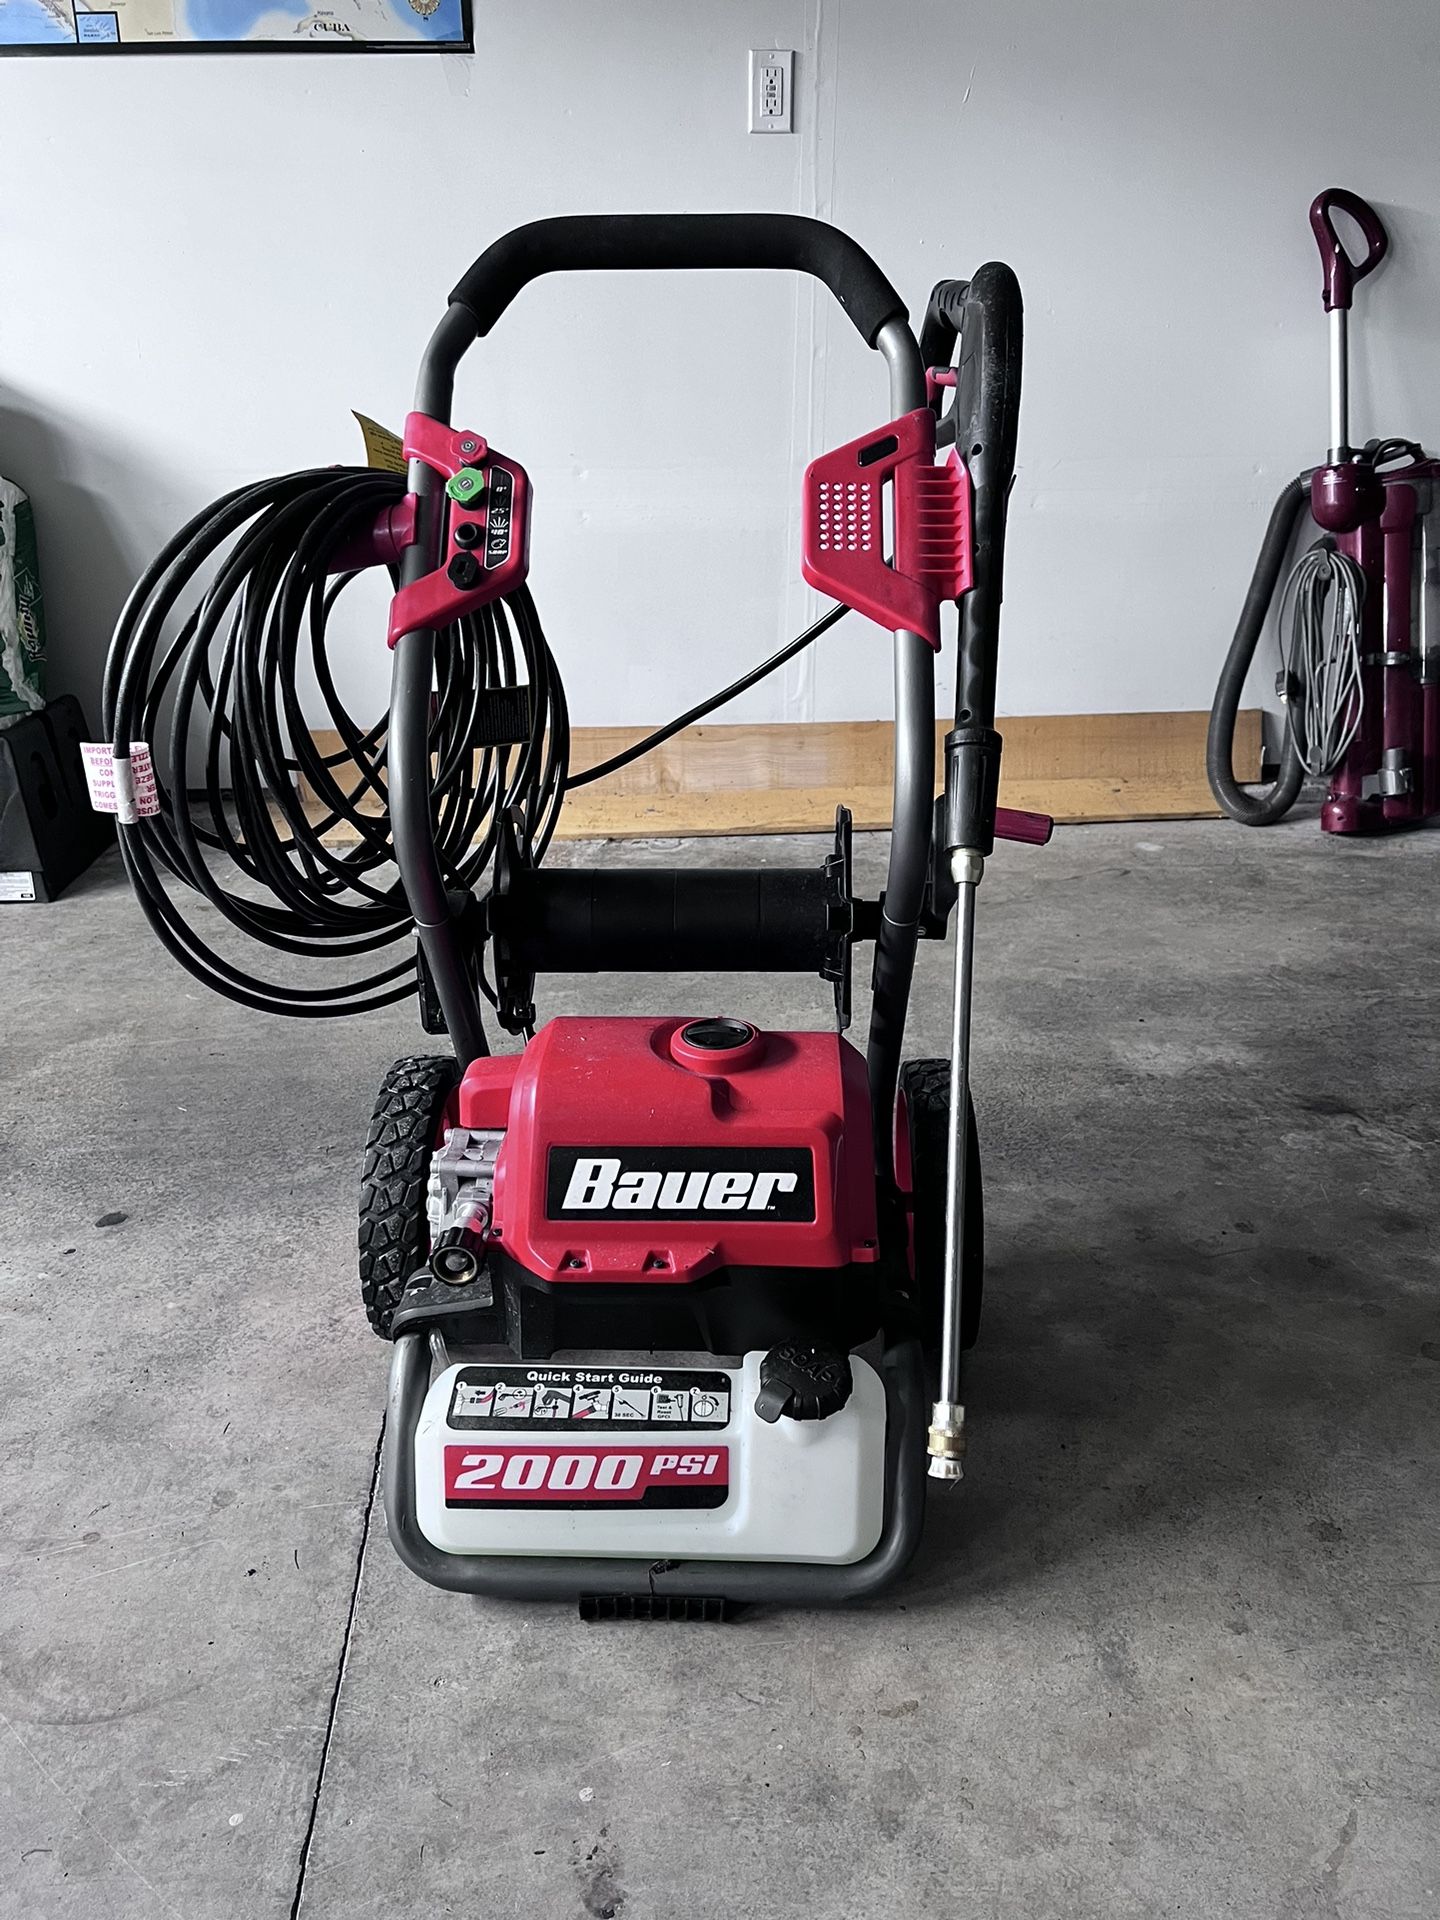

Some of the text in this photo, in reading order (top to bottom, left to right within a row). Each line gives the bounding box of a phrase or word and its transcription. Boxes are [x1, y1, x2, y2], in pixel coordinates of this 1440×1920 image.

[314, 23, 351, 32] CUBA
[561, 1158, 798, 1210] Bauer
[526, 1370, 663, 1384] Quick Start Guide
[453, 1453, 720, 1490] 2000 PSI
